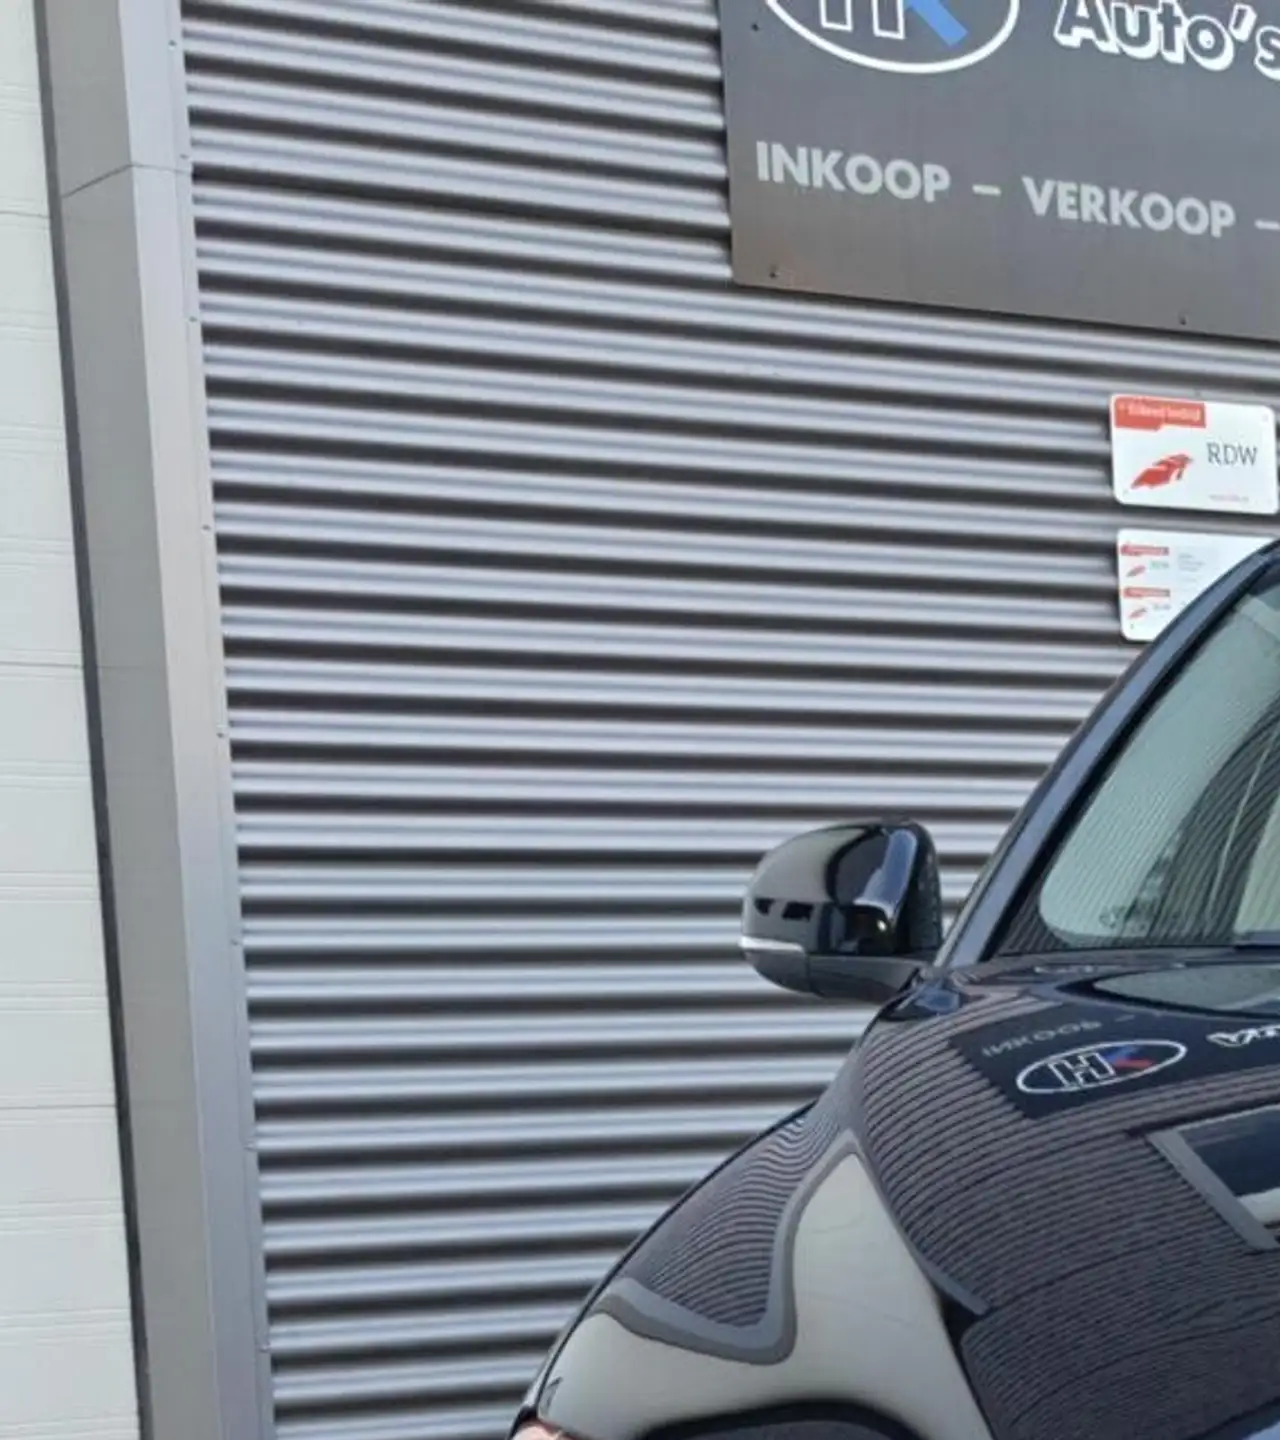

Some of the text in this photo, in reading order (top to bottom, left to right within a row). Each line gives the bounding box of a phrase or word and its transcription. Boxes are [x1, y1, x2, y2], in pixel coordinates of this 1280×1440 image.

[755, 140, 952, 203] INKOOP
[1021, 176, 1237, 239] VERKOOP
[1206, 442, 1258, 467] RDW
